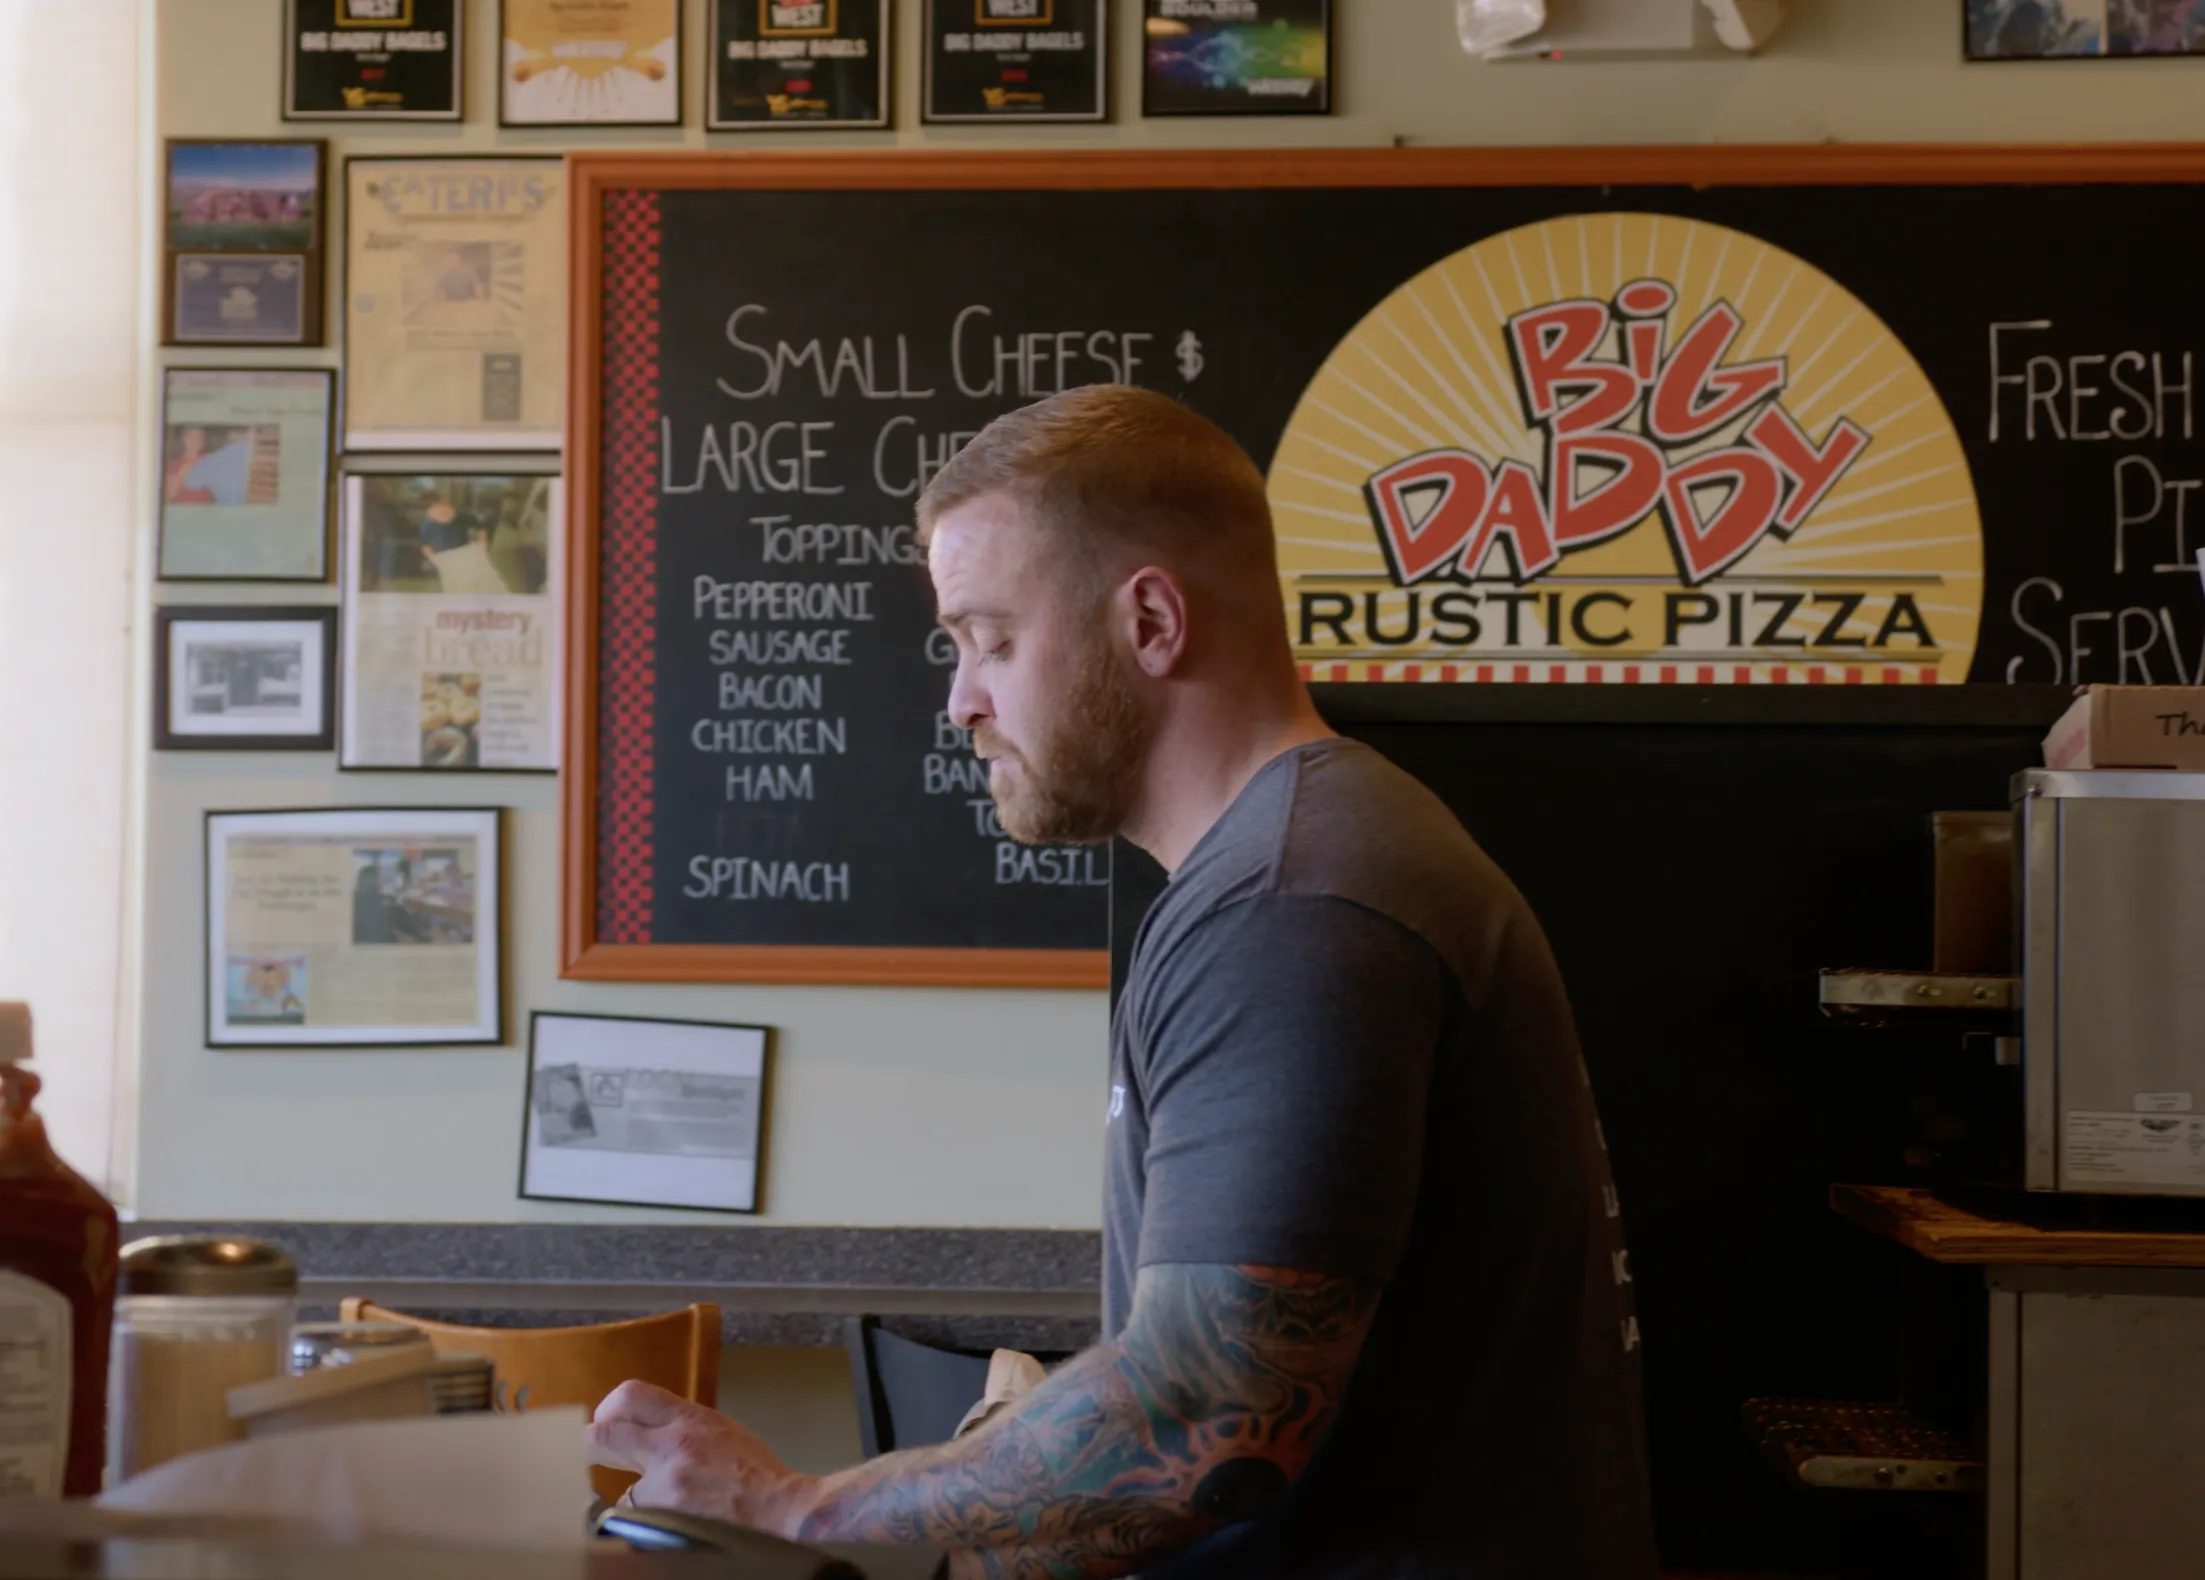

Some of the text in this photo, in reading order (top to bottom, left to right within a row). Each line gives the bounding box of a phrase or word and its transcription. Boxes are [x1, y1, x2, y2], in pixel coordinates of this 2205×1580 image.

[716, 304, 936, 399] SMALL
[1174, 329, 1205, 384] $
[1988, 319, 2193, 443] FRESH
[661, 415, 846, 494] LARGE
[1363, 400, 1872, 586] DADDY
[693, 575, 875, 621] PEPPERONI
[1299, 591, 1938, 646] RUSTIC PIZZA
[437, 609, 534, 634] mystery
[708, 629, 853, 666] SAUSAGE
[718, 671, 823, 711] BACON
[691, 717, 847, 755] CHICKEN
[725, 763, 815, 802] HAM
[682, 855, 850, 901] SPINACH
[994, 842, 1110, 887] BASIL
